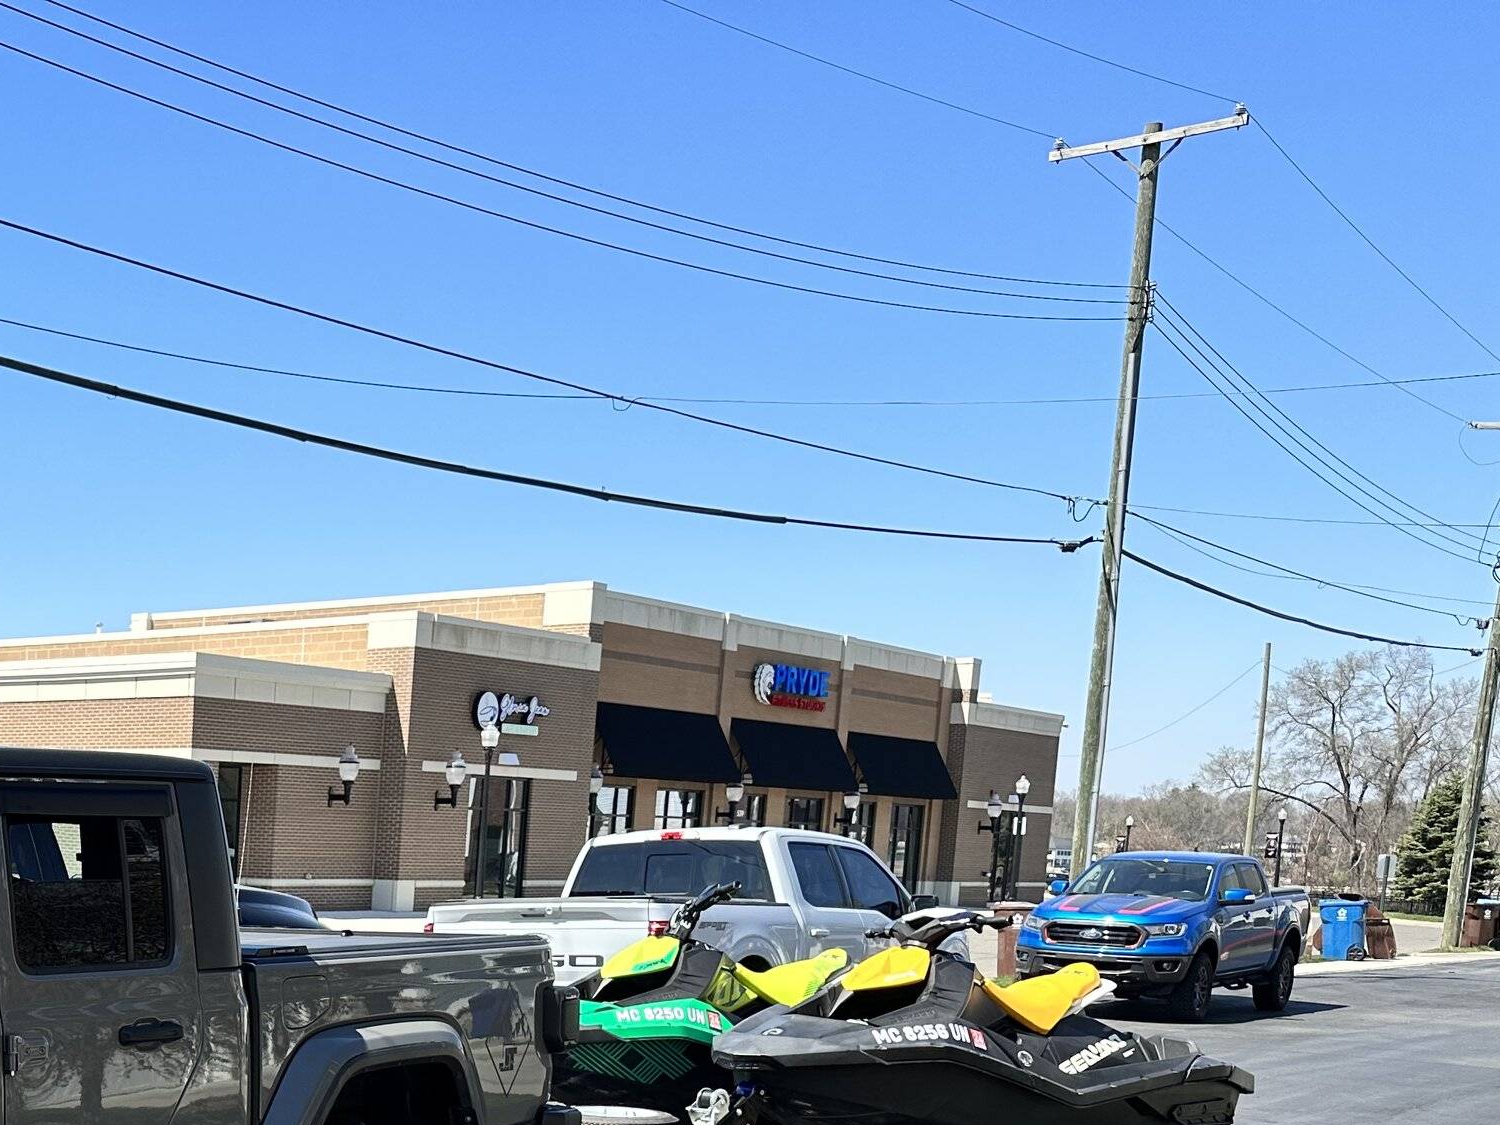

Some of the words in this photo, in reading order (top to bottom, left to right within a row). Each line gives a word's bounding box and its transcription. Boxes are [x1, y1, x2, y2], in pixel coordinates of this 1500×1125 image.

[774, 664, 830, 697] PRYDE
[615, 1008, 641, 1023] MC
[687, 1007, 706, 1025] UN
[871, 1027, 903, 1045] MC
[948, 1022, 971, 1043] UN
